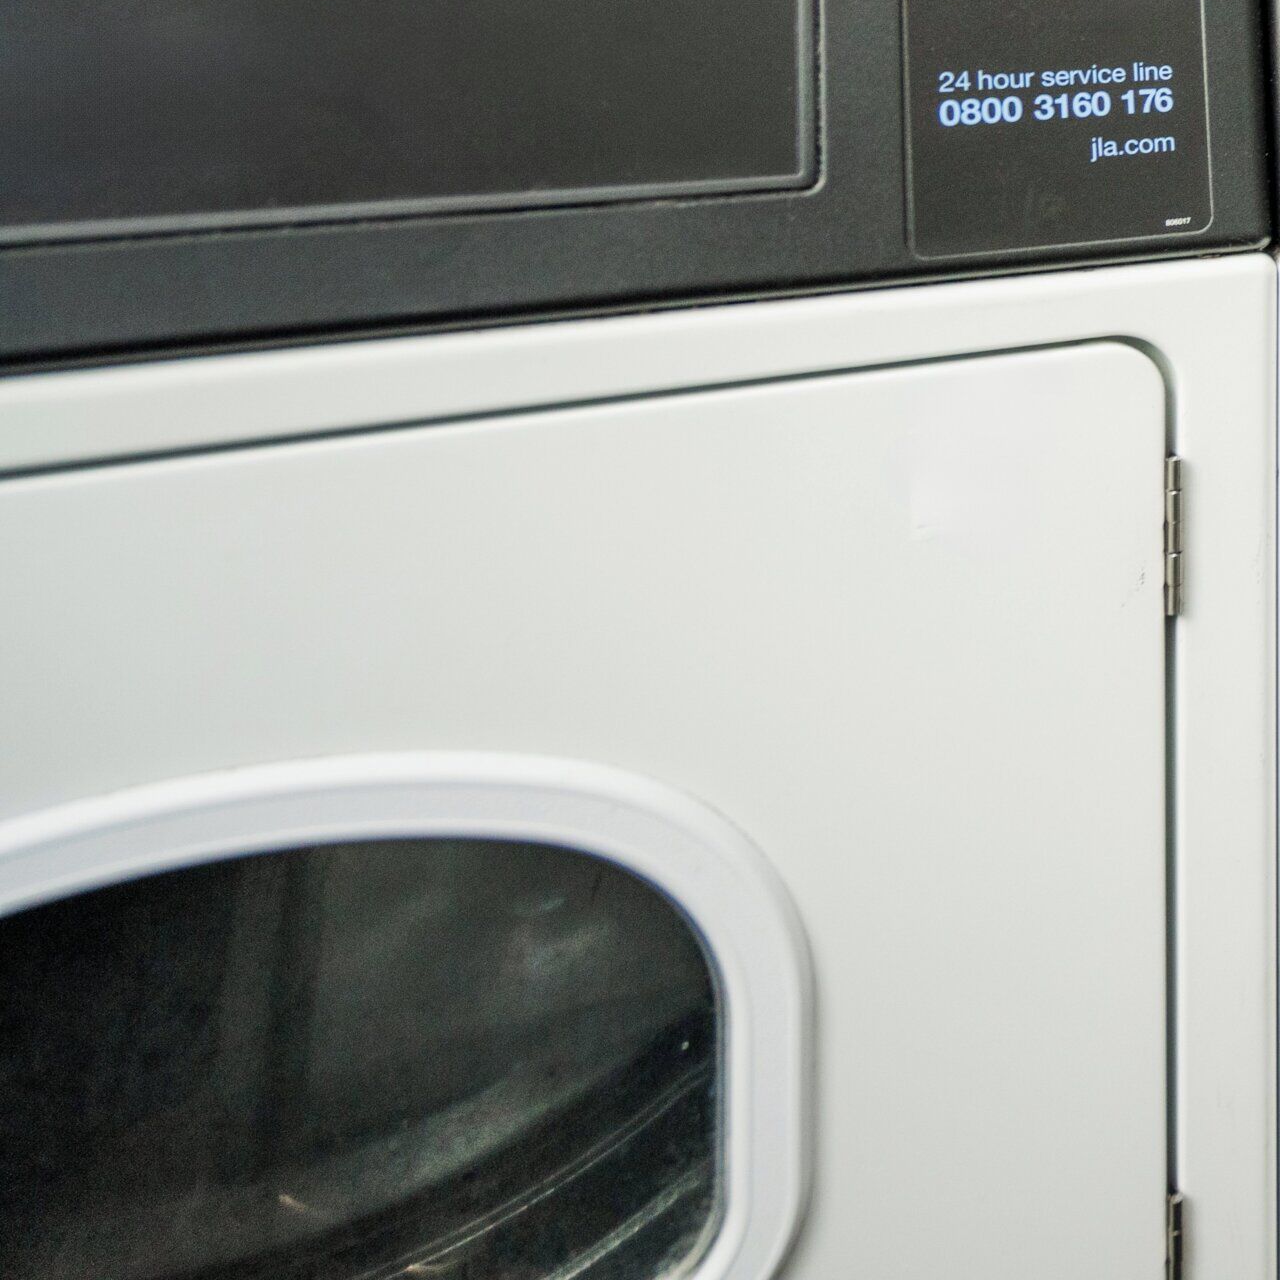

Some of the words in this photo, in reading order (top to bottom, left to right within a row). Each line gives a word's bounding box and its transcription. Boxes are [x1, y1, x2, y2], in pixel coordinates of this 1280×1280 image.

[938, 71, 972, 93] 24
[977, 67, 1034, 91] hour
[1041, 63, 1127, 87] service
[1133, 61, 1173, 82] line
[938, 96, 1023, 127] 0800
[1034, 91, 1111, 121] 3160
[1121, 87, 1174, 115] 176
[1090, 134, 1176, 163] jla.com
